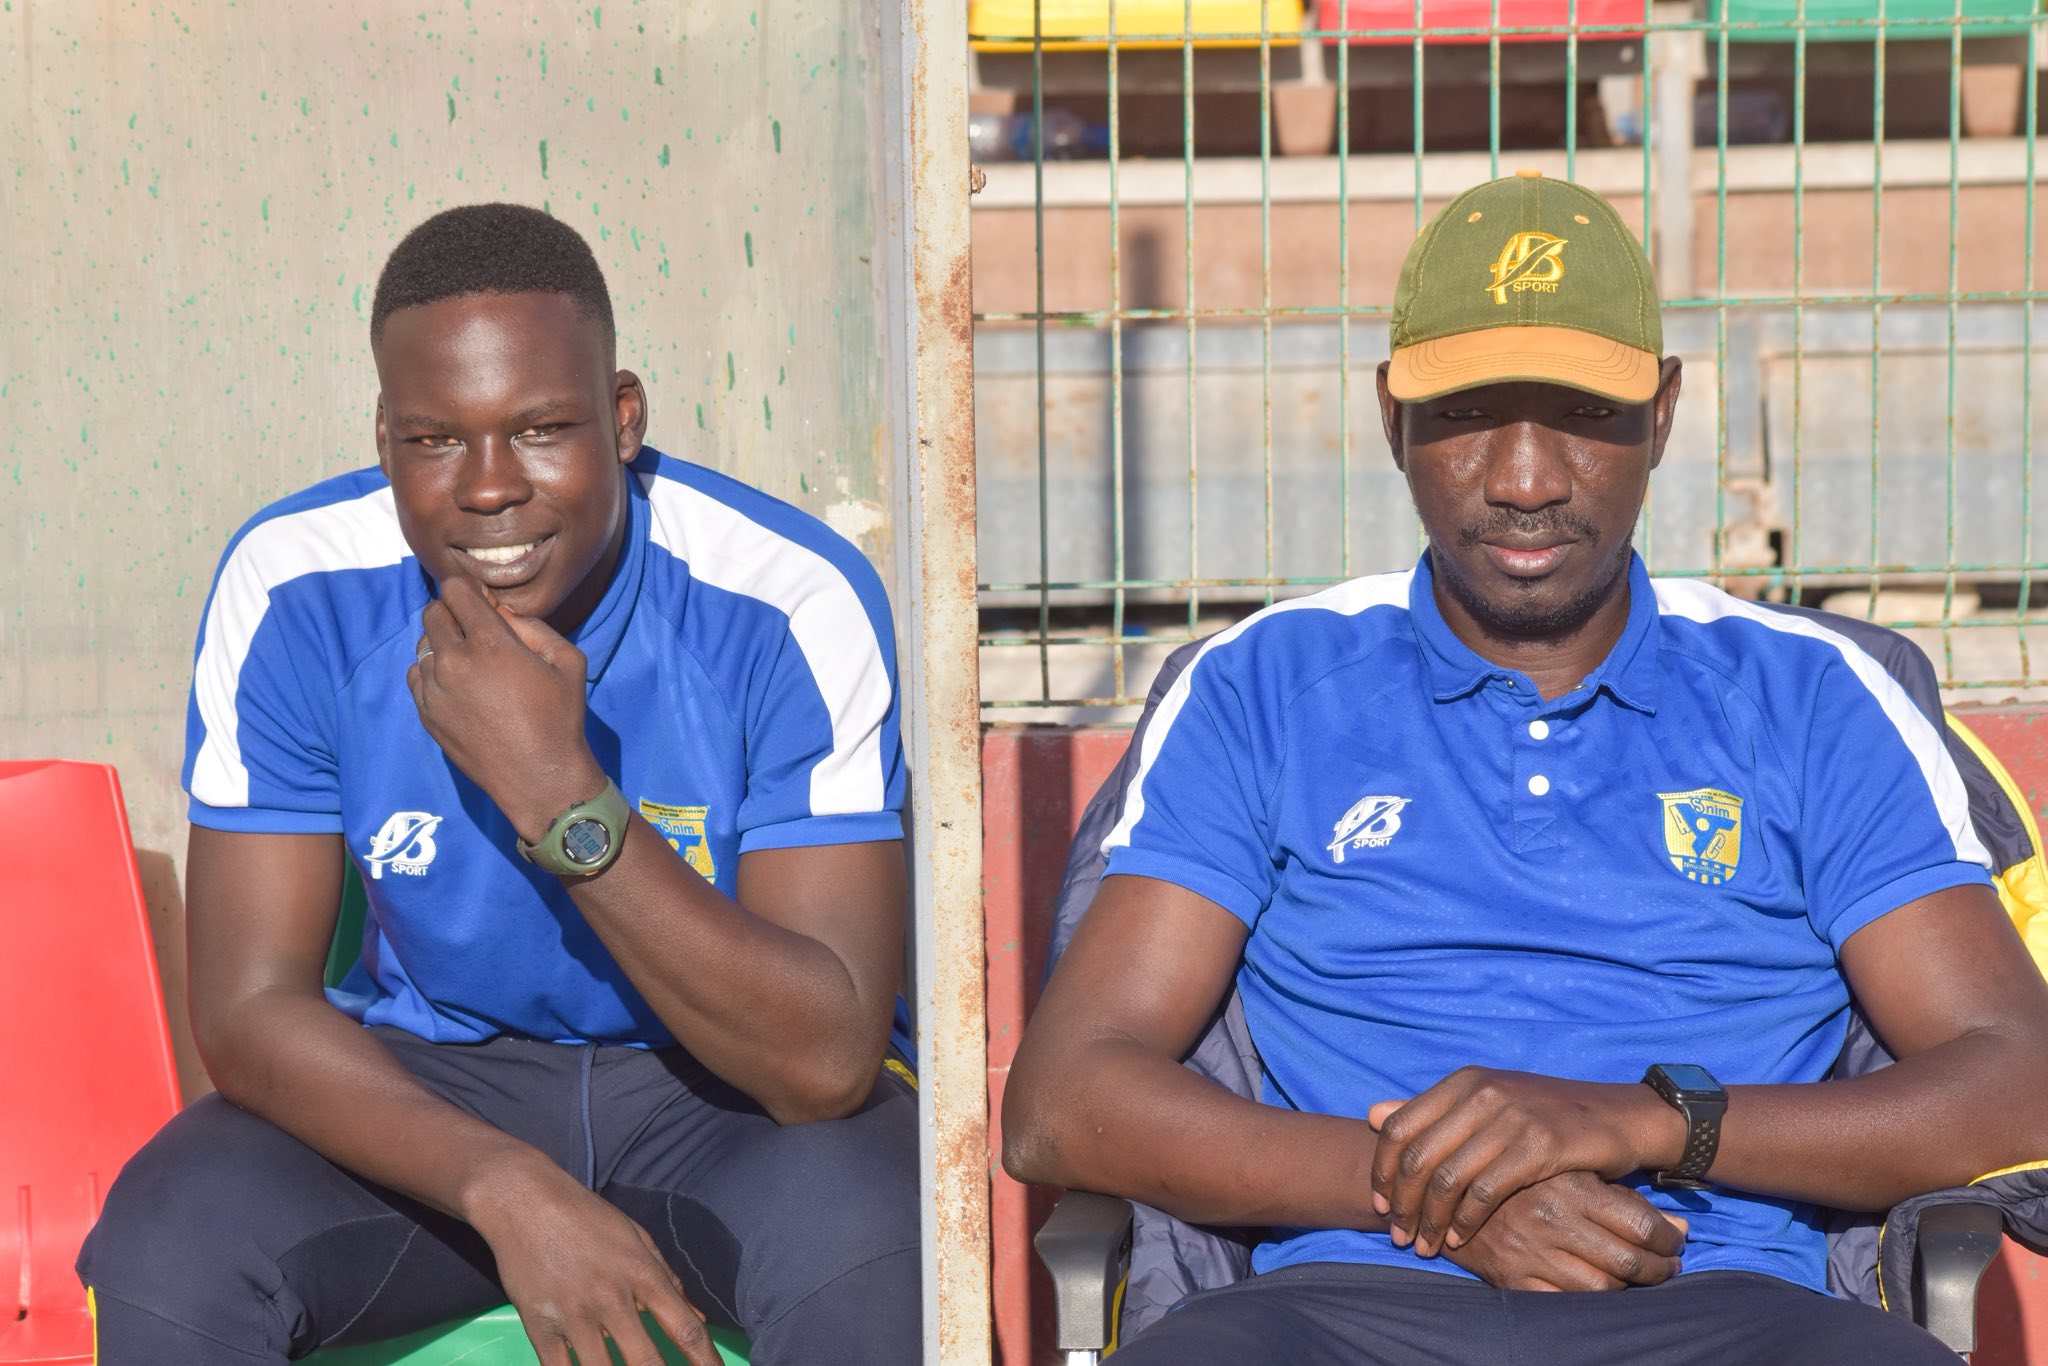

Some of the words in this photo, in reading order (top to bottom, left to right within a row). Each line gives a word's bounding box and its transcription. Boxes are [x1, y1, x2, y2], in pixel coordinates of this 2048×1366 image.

[1513, 282, 1559, 293] SPORT
[1690, 798, 1730, 818] Snim
[1353, 837, 1392, 849] SPORT
[391, 863, 428, 876] SPORT
